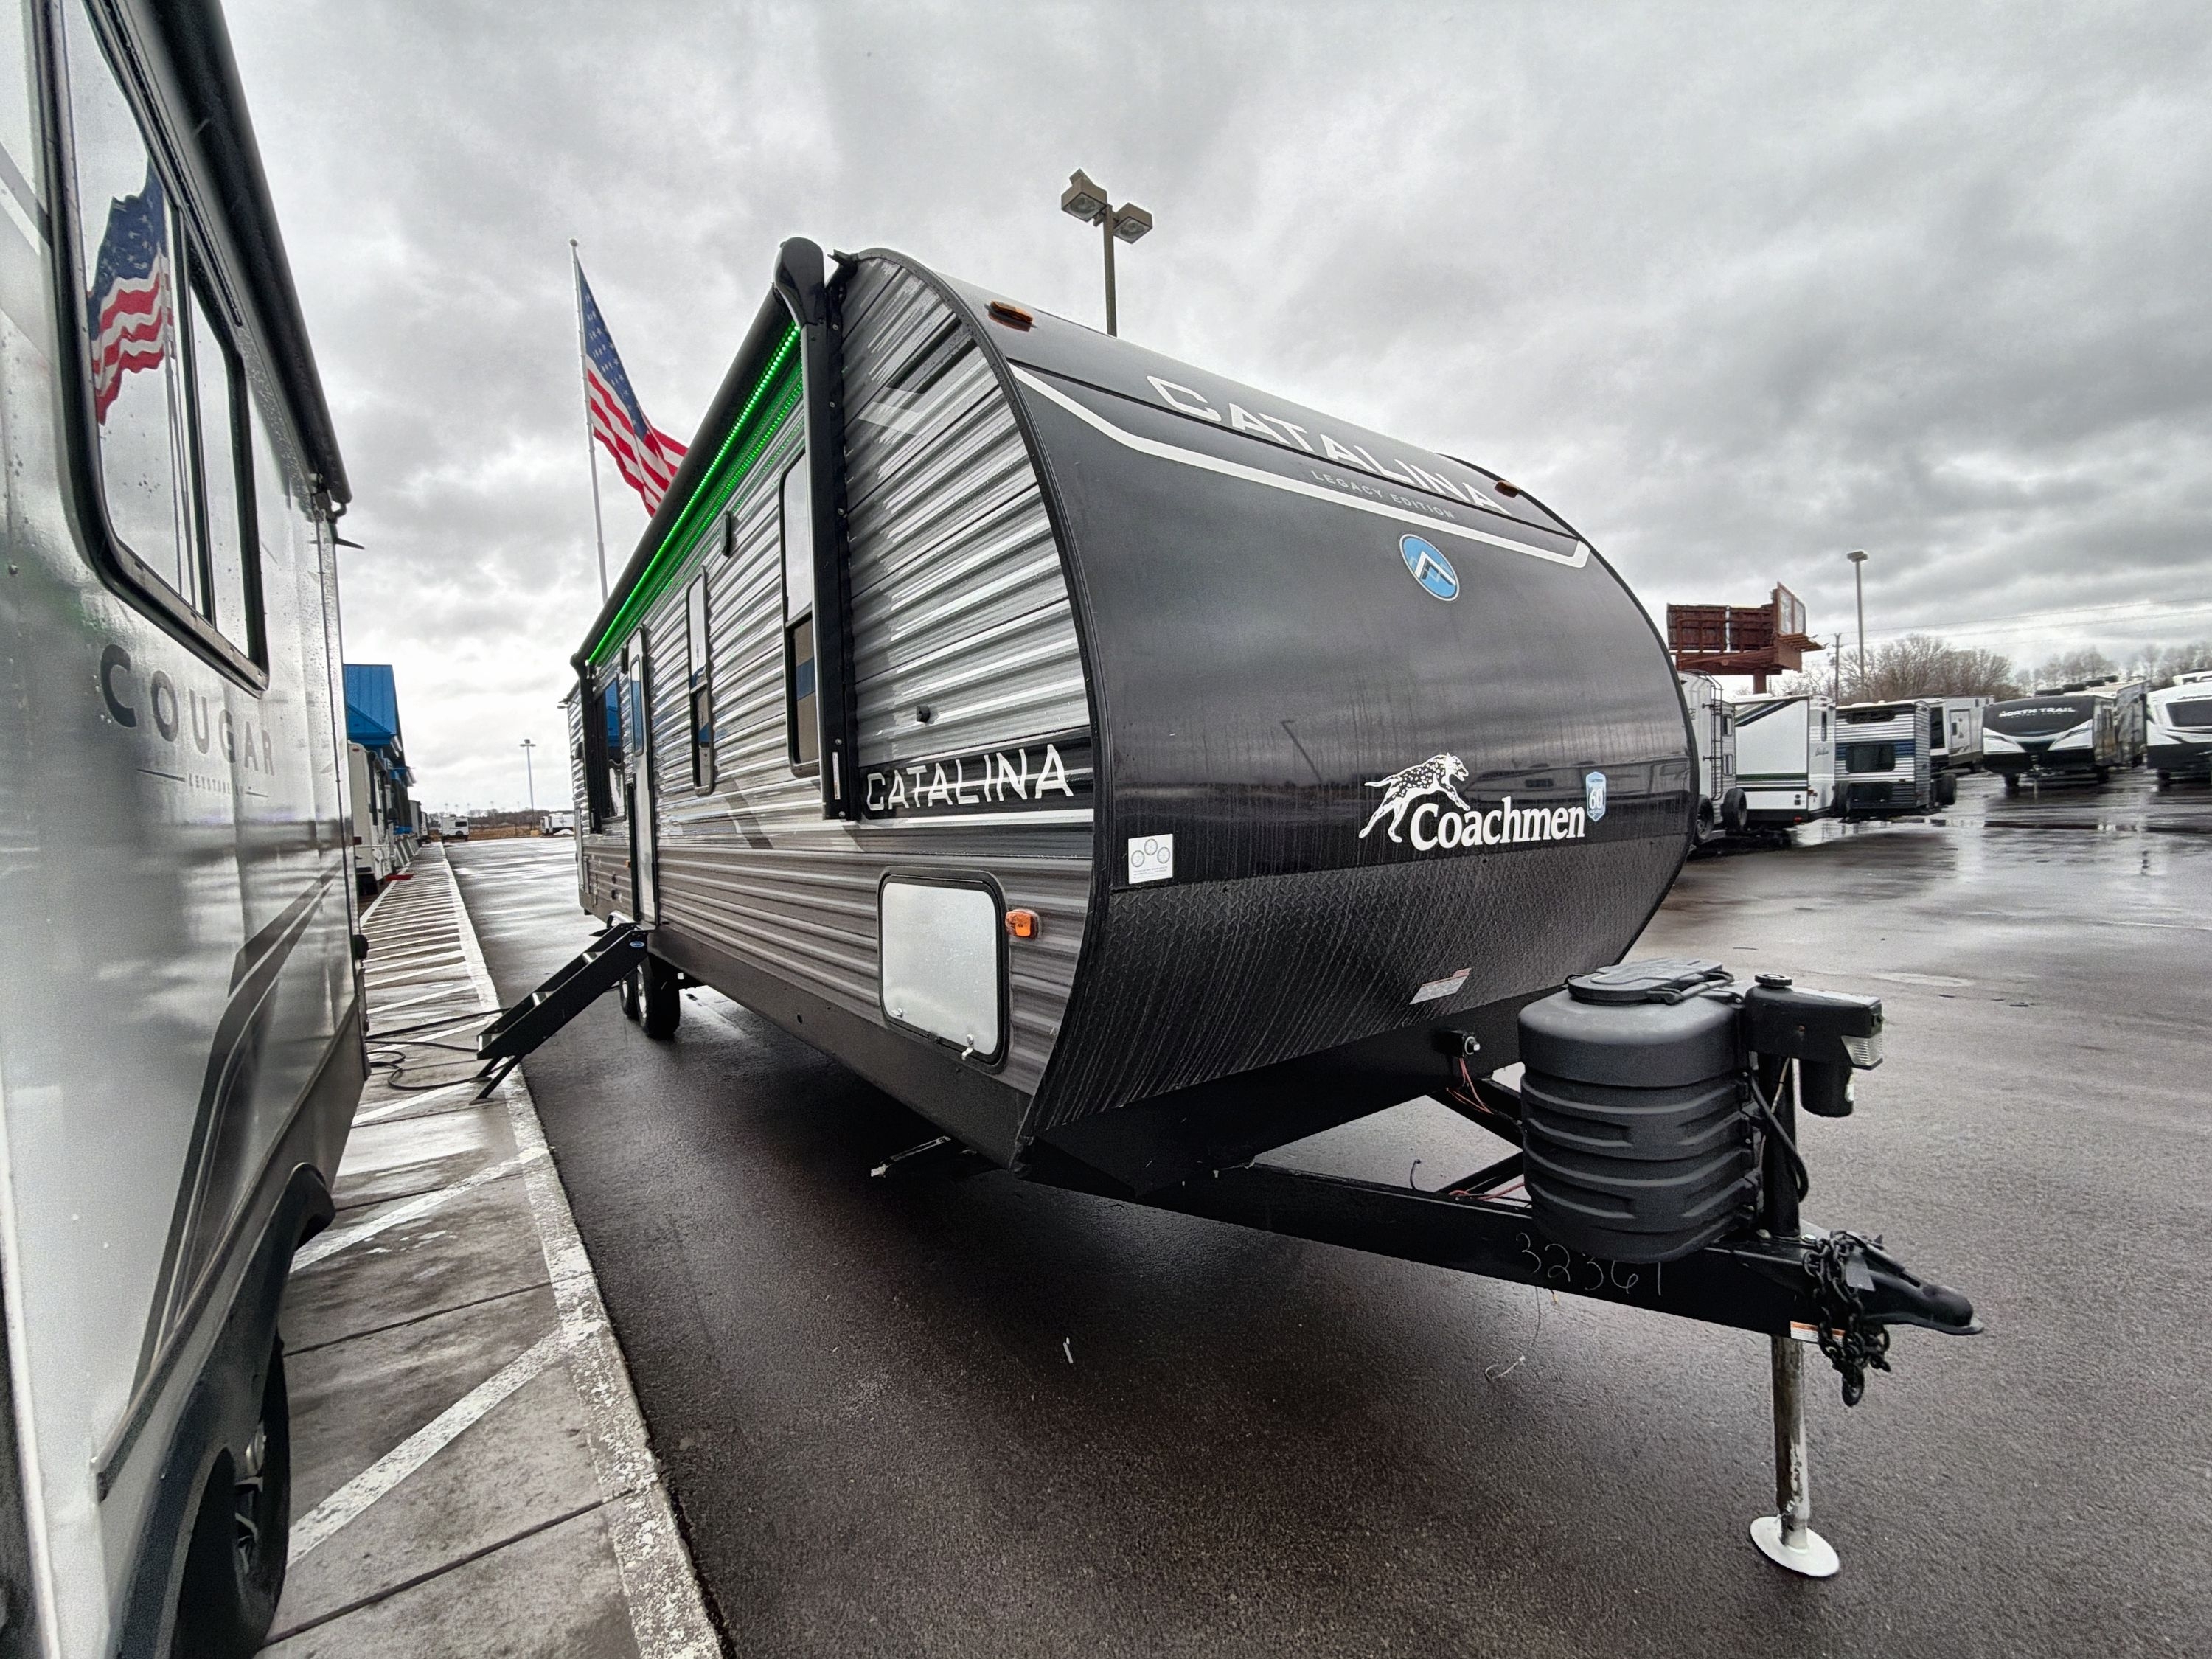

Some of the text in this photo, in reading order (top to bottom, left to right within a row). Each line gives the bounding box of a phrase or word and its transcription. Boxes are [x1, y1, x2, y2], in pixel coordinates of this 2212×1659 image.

[1147, 375, 1512, 515] CATALINA
[1310, 470, 1456, 519] LEGACY EDITION
[100, 643, 276, 776] COUGAR
[866, 744, 1074, 811] CATALINA
[1589, 788, 1603, 810] 60
[1410, 796, 1585, 851] Coachmen
